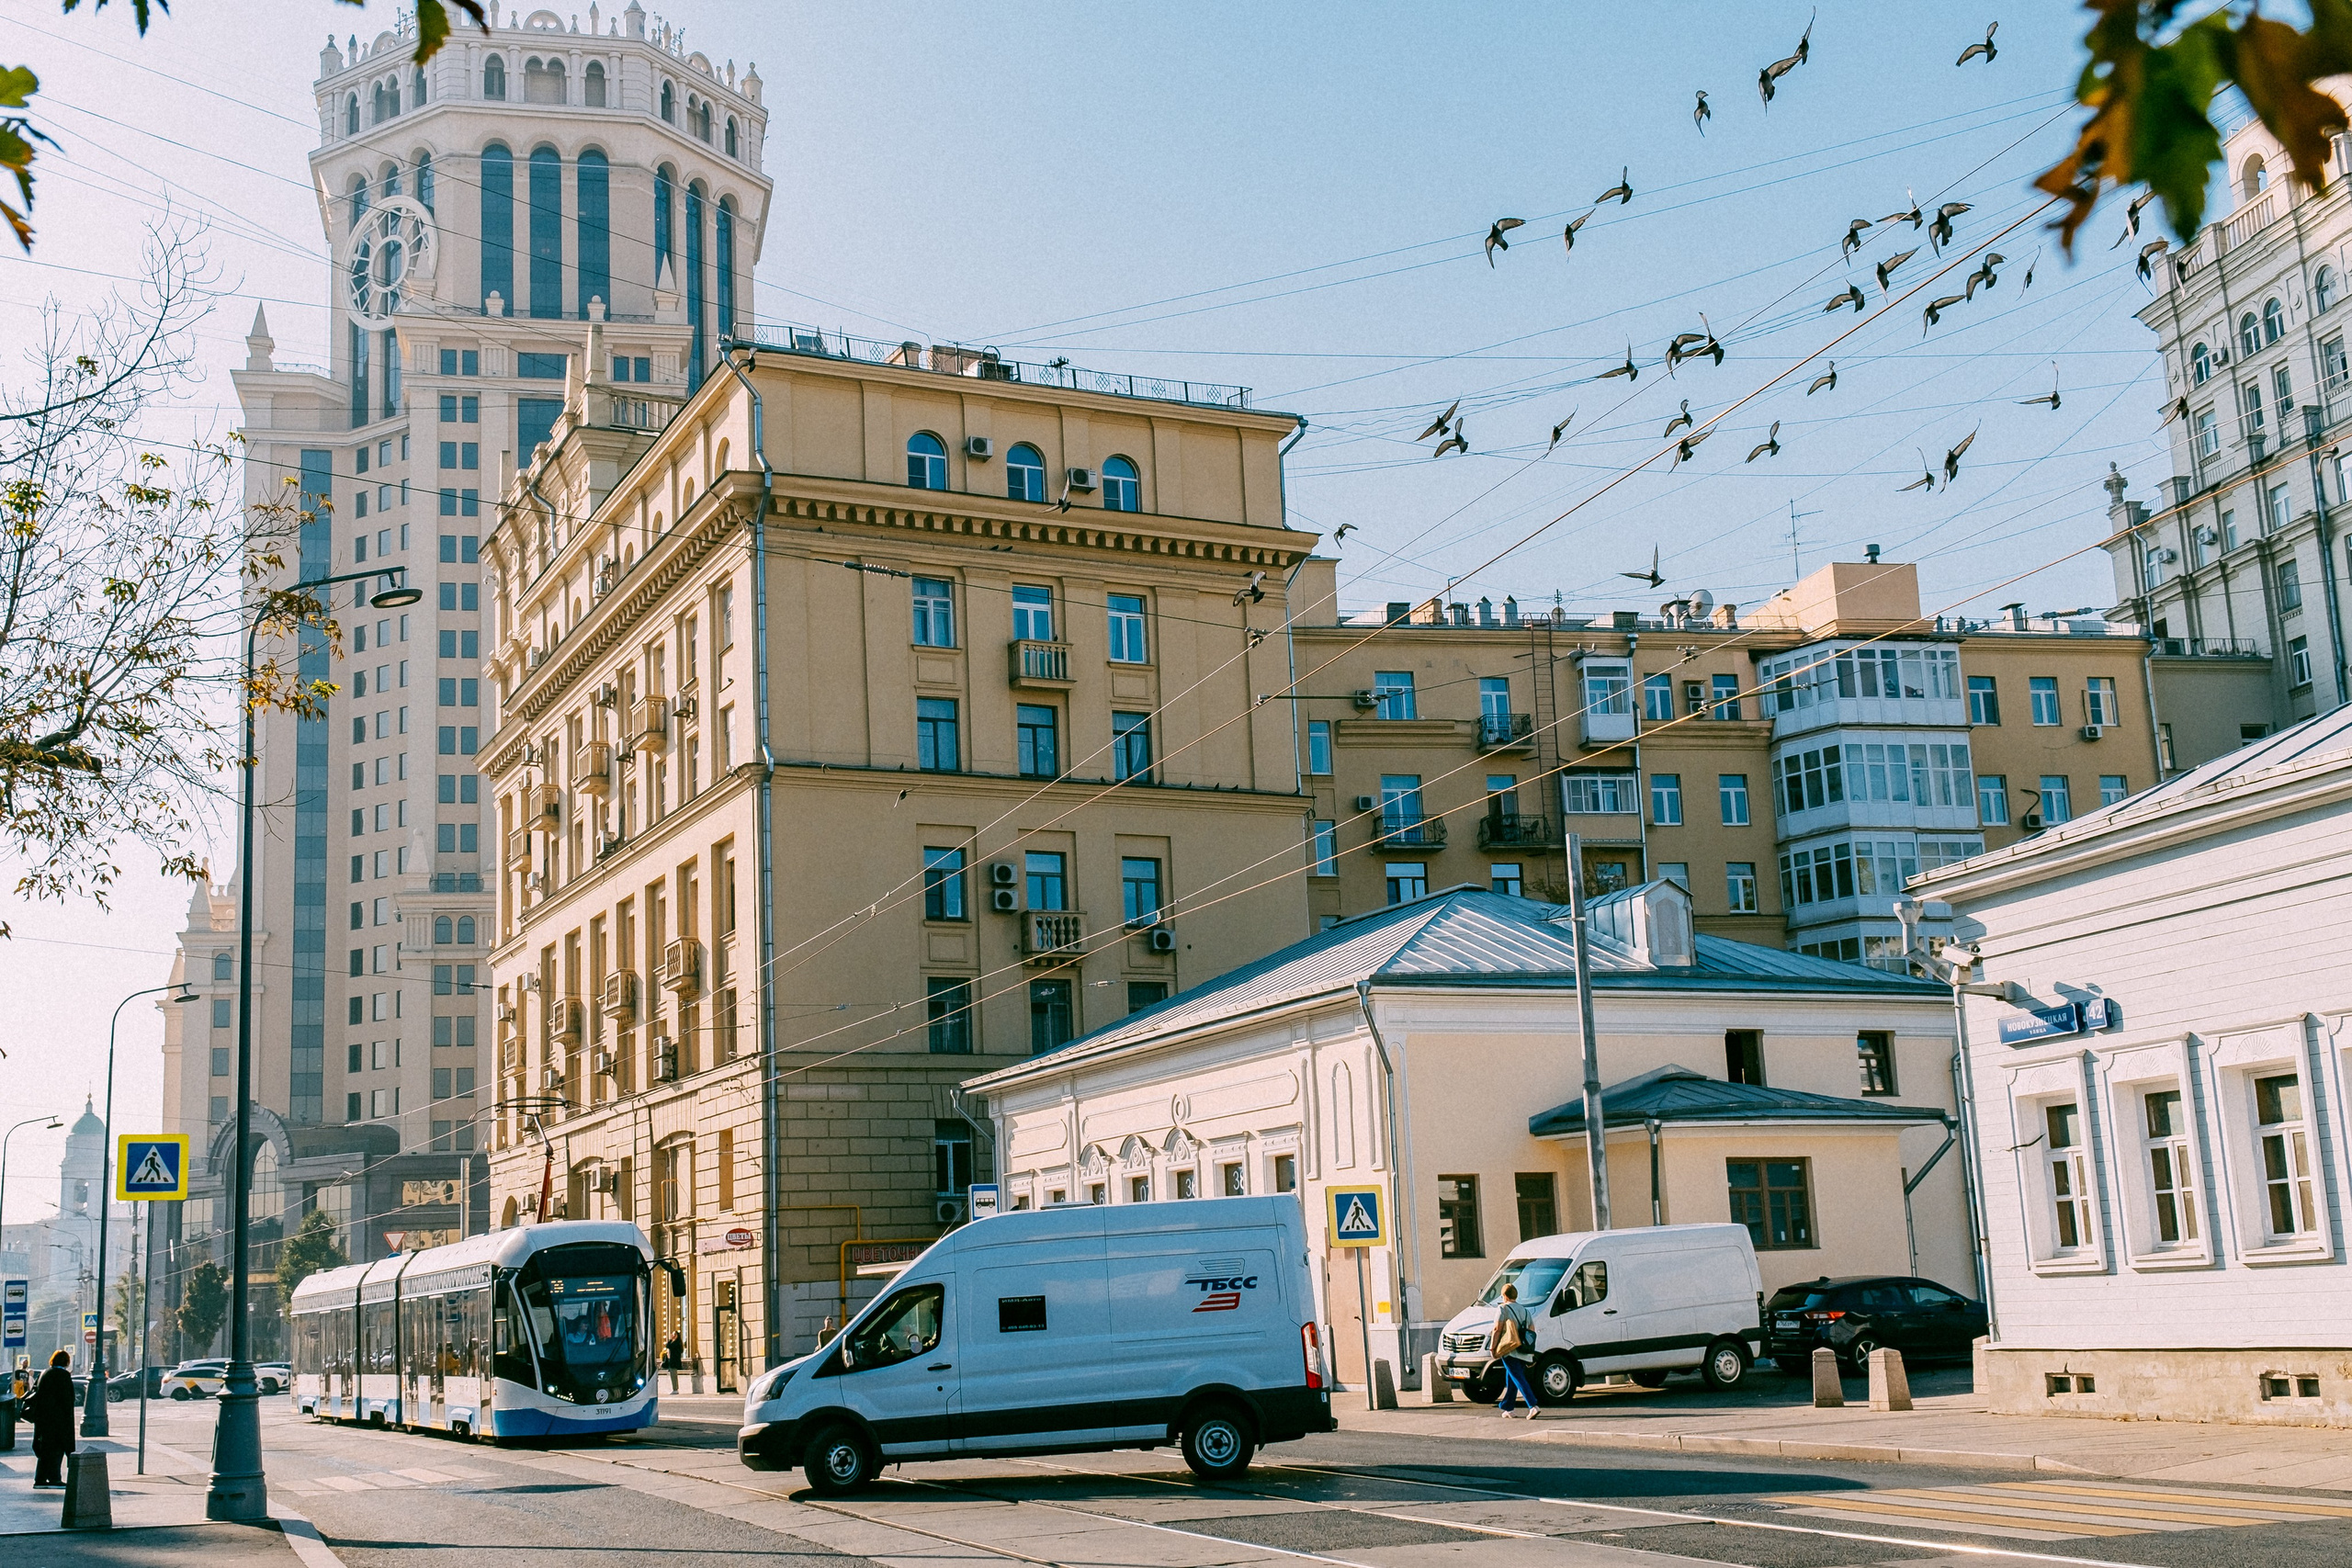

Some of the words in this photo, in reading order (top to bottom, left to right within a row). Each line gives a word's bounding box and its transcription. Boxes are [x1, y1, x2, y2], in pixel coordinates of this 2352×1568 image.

[2088, 1005, 2103, 1020] 42
[2007, 1012, 2067, 1032] НОВОКУЗНЕЦКАЯ
[727, 1232, 752, 1241] ЦВЕТЫ
[1184, 1276, 1258, 1292] ТБСС
[595, 1407, 612, 1416] 31191
